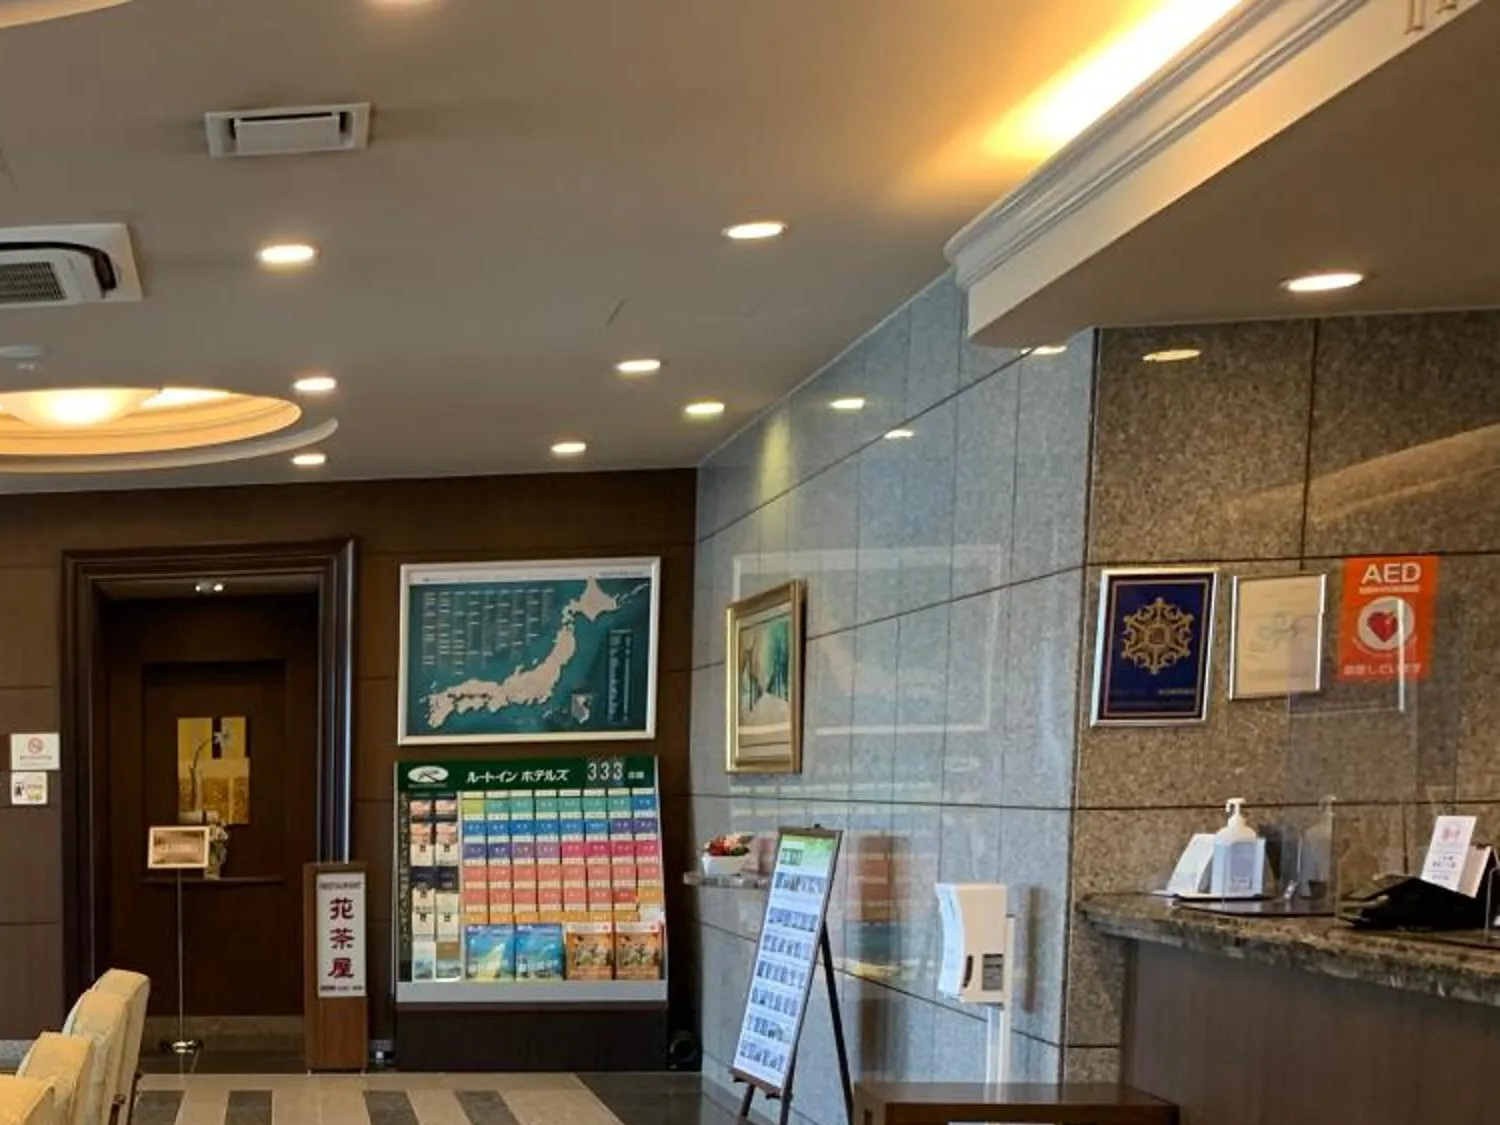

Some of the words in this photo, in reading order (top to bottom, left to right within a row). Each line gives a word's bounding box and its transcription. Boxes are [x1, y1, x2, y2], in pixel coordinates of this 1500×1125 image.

[1361, 562, 1422, 585] AED
[467, 769, 518, 784] ルートイン
[520, 767, 571, 782] ホテルズ
[586, 760, 624, 782] 333
[327, 896, 356, 979] 花茶屋
